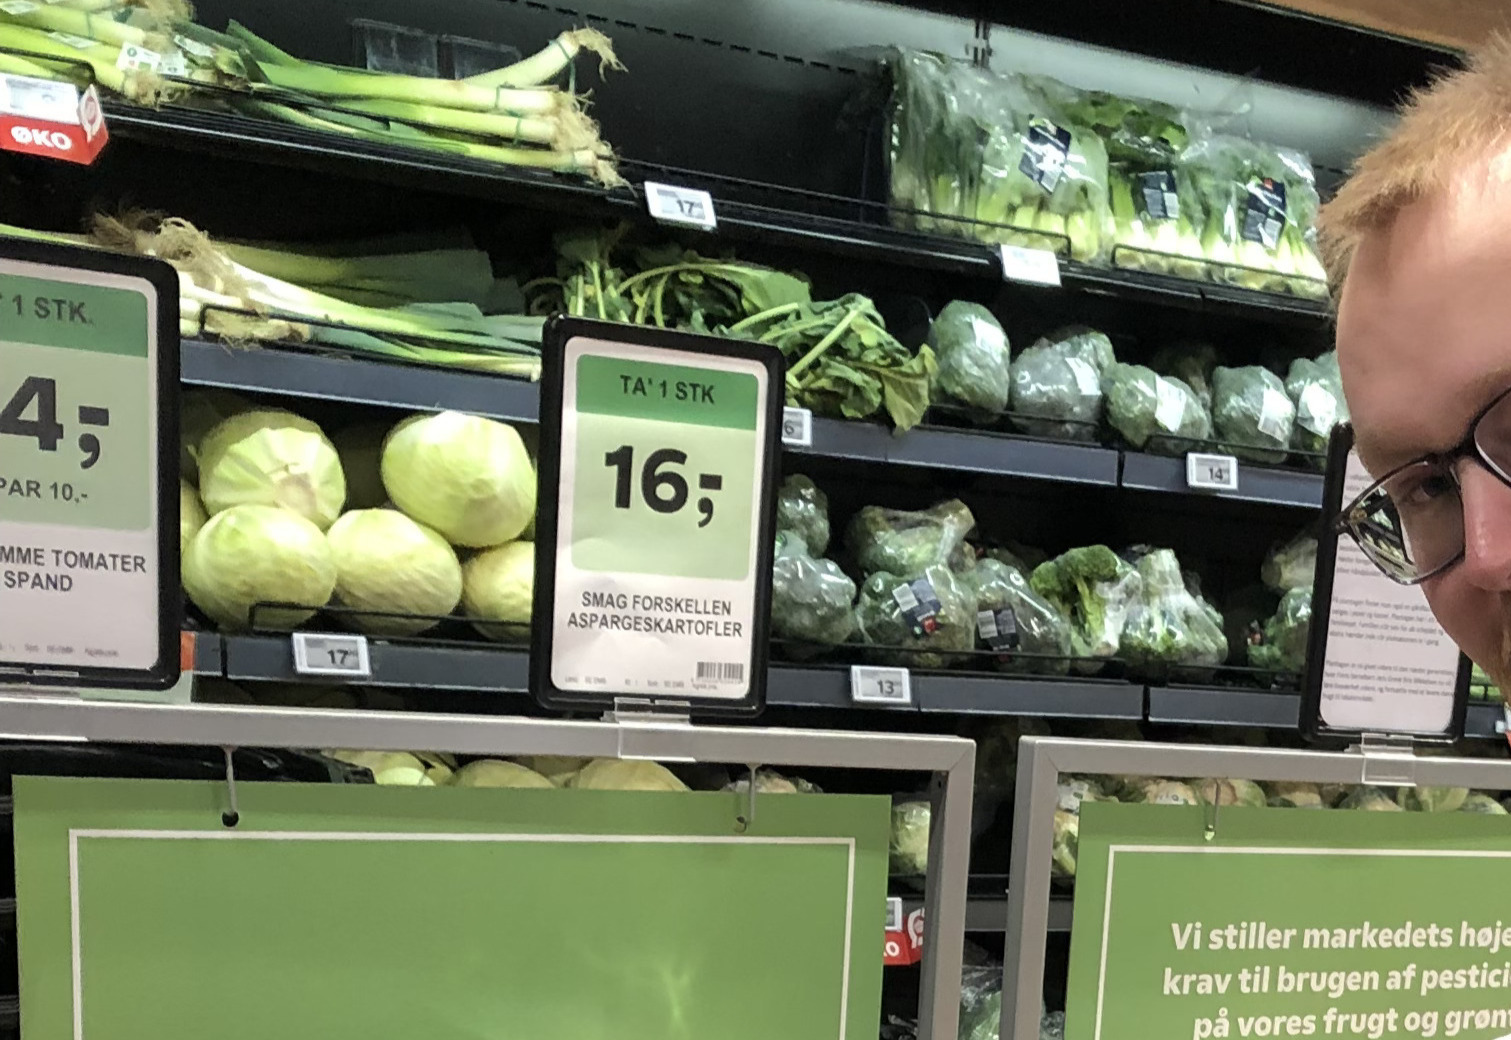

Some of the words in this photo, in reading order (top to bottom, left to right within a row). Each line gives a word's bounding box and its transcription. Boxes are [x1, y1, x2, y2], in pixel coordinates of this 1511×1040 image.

[11, 126, 72, 150] ØKO
[12, 294, 22, 316] 1
[660, 380, 667, 398] 1
[675, 381, 715, 404] STK
[1209, 466, 1223, 480] 14
[52, 549, 147, 573] TOMATER
[4, 571, 73, 592] SPAND
[582, 591, 628, 610] SMAG
[632, 594, 731, 616] FORSKELLEN
[567, 612, 742, 637] ASPARGESKARTOFLER
[877, 680, 894, 695] 13
[1171, 921, 1201, 950] Vi
[1208, 921, 1297, 950] stiller
[1303, 921, 1453, 949] markedets
[1162, 967, 1232, 995] krav
[1238, 967, 1270, 993] til
[1277, 965, 1379, 998] brugen
[1386, 963, 1416, 990] af
[1237, 1013, 1316, 1037] vores
[1322, 1006, 1398, 1039] frugt
[1404, 1012, 1438, 1037] og
